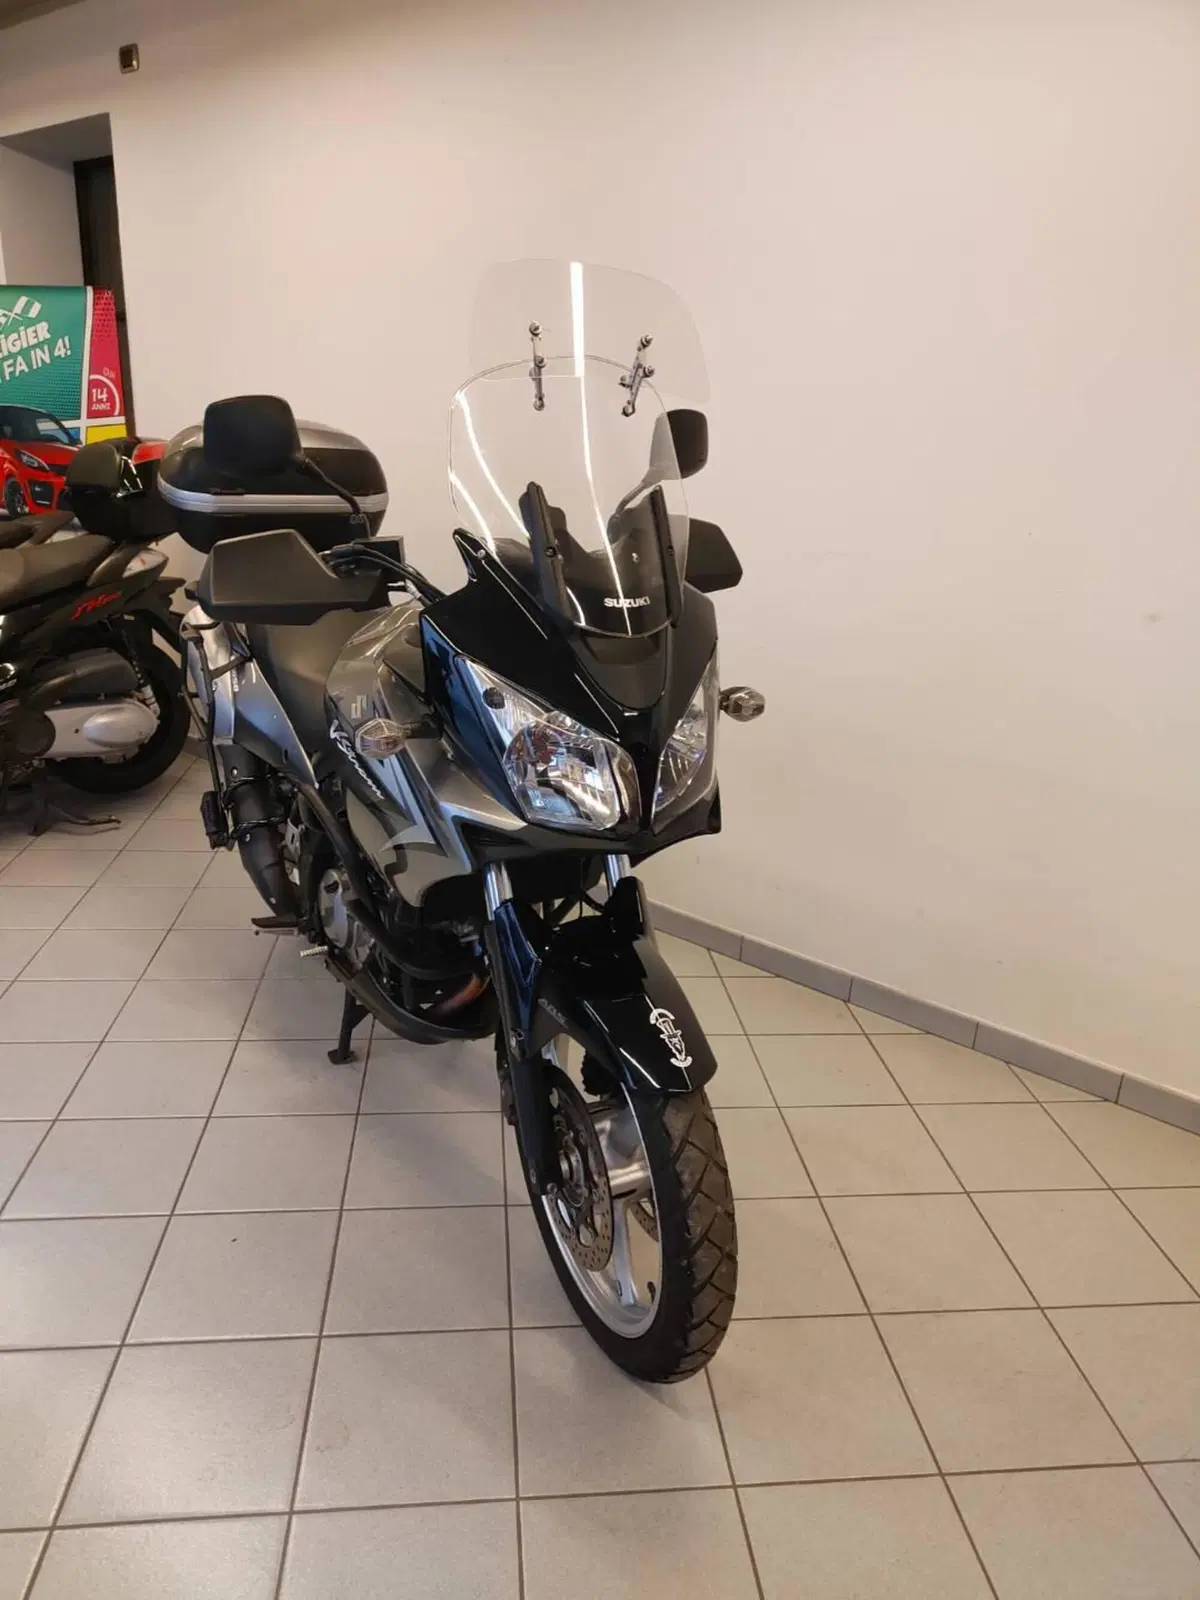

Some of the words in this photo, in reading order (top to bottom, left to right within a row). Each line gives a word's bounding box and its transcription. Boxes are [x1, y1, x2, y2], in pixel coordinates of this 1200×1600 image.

[0, 321, 51, 358] IGIER
[3, 355, 29, 380] FA
[31, 344, 51, 369] IN
[54, 335, 71, 358] 4!
[92, 388, 108, 402] 14
[603, 596, 651, 608] SUZUKI
